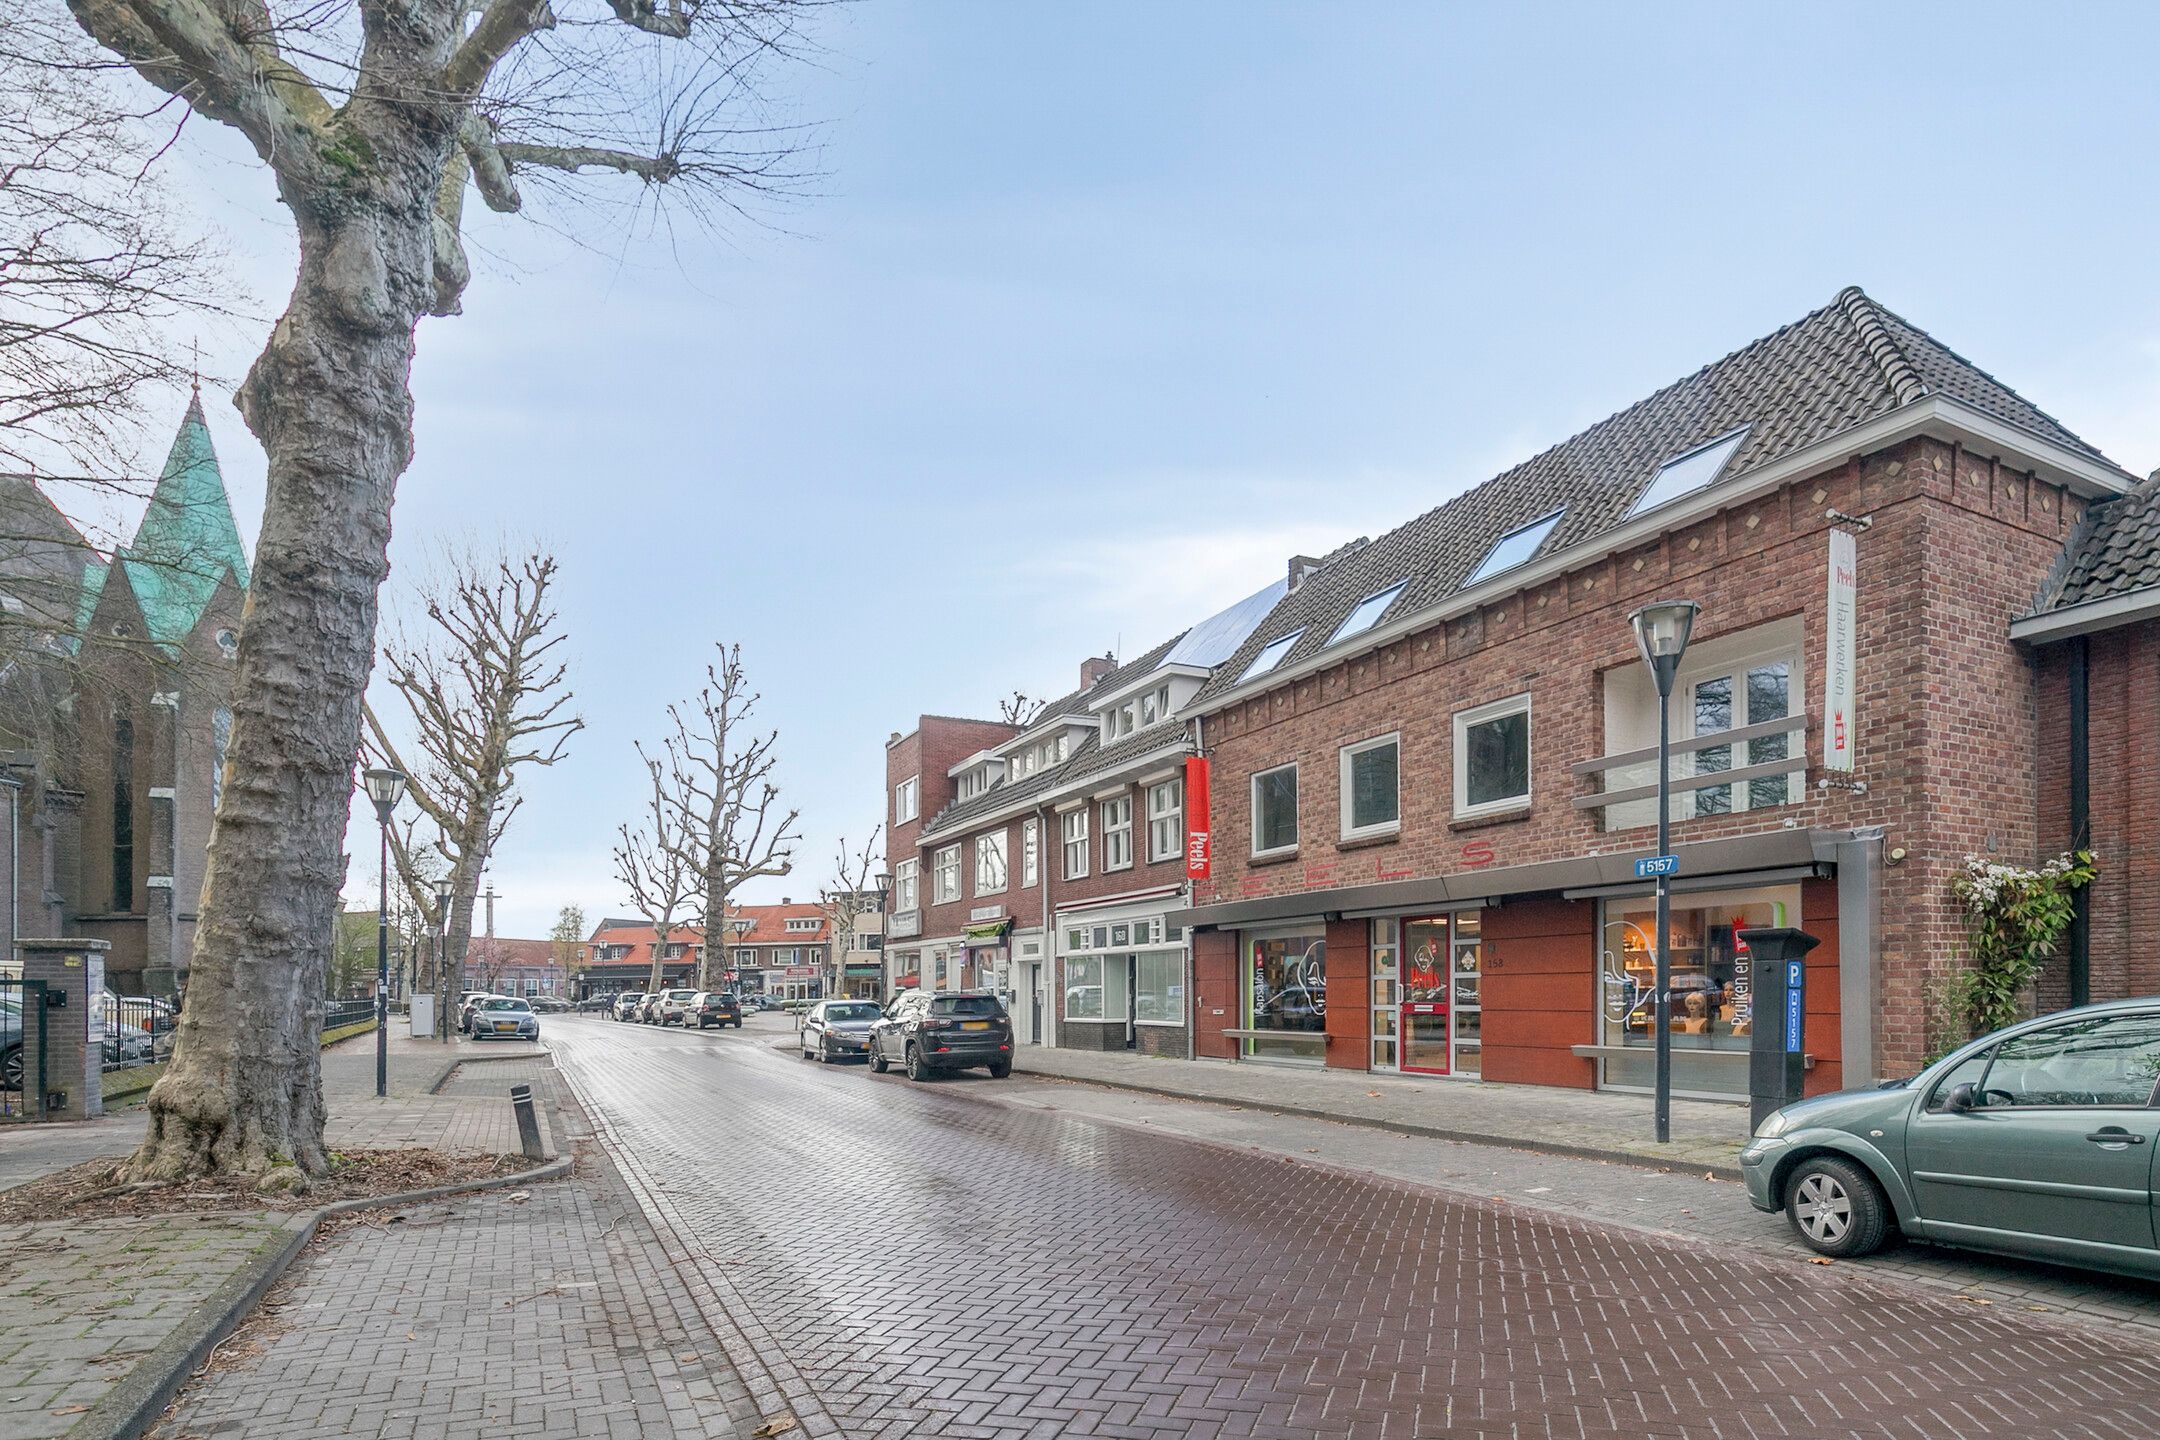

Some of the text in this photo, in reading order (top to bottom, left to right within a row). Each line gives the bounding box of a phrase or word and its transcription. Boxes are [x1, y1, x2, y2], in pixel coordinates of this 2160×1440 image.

[1835, 601, 1849, 696] Haarwerken
[1190, 831, 1208, 870] Peels
[1646, 859, 1673, 872] 5157
[1734, 957, 1748, 974] en
[1790, 965, 1799, 984] P
[1254, 968, 1265, 1015] Kapsalon
[1731, 976, 1748, 1026] Pruiken
